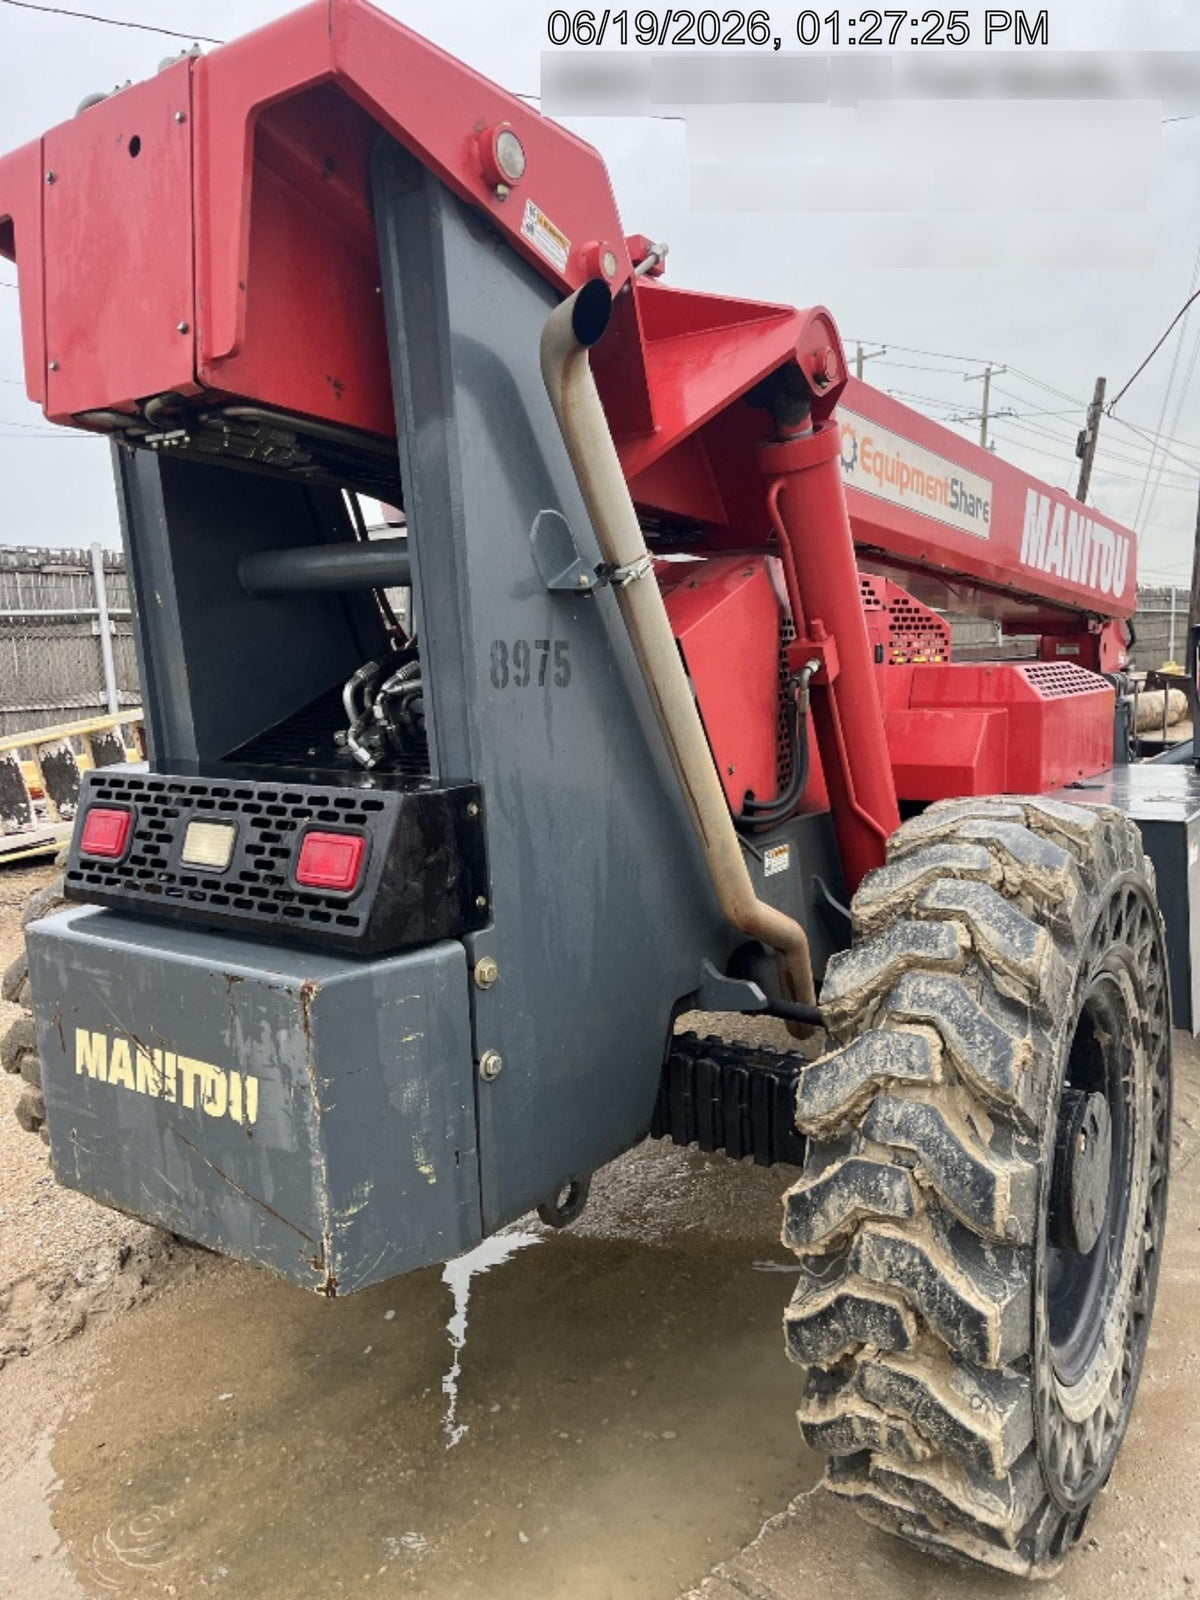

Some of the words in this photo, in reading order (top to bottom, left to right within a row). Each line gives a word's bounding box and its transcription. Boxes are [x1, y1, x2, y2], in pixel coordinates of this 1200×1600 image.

[860, 436, 990, 524] EquipmentShare
[1020, 488, 1129, 598] MANITOU
[490, 639, 572, 689] 8975
[75, 1027, 259, 1126] MANITOU
